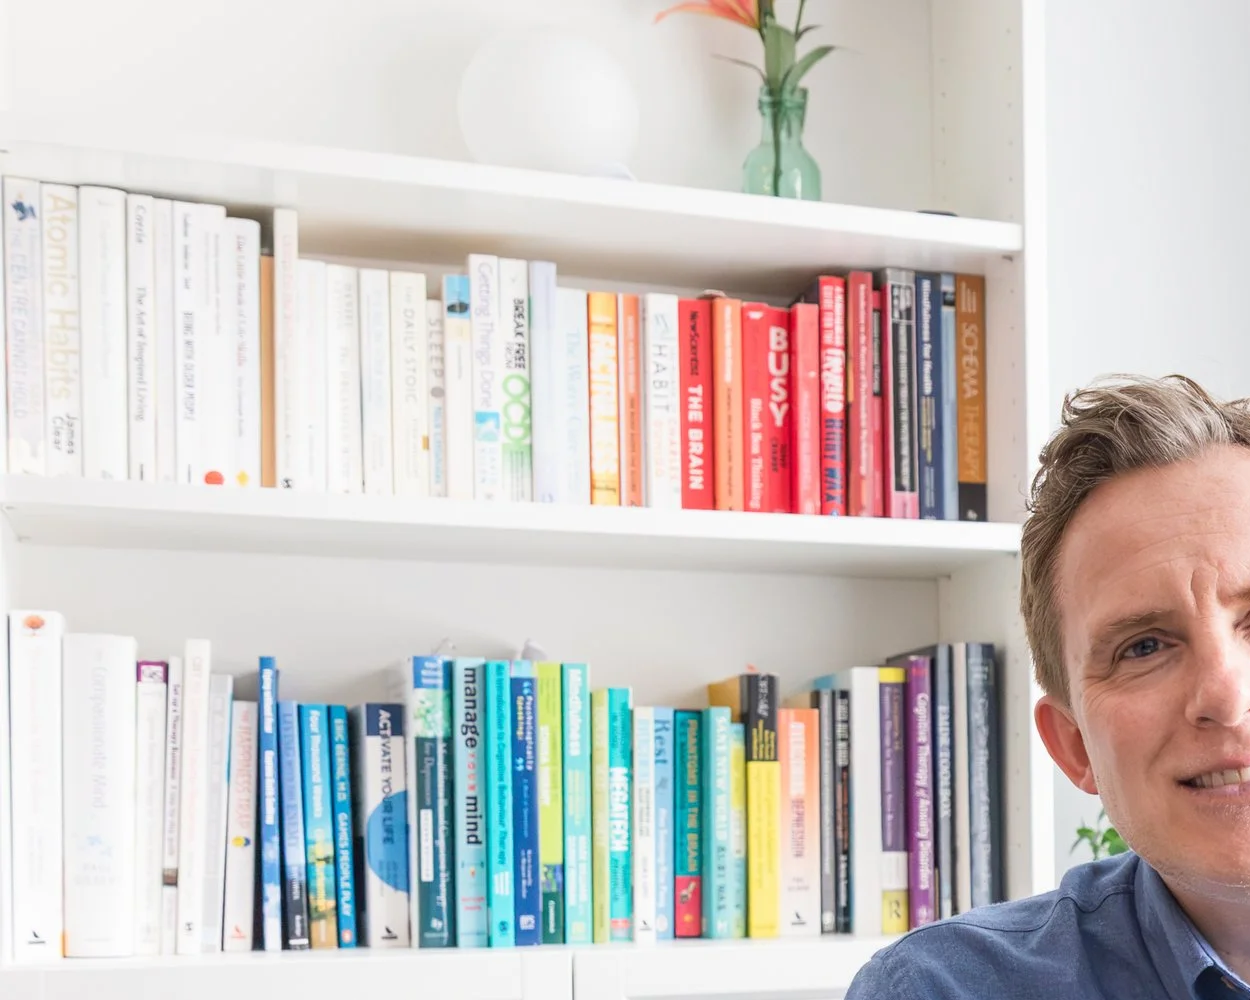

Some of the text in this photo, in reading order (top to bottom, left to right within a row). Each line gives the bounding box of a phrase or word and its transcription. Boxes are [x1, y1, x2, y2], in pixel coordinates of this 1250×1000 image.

[46, 194, 77, 400] Atomic Habits
[922, 279, 932, 342] Mindfulness
[403, 308, 418, 404] DAILY STOIC
[429, 317, 445, 378] SLEEP
[475, 262, 495, 409] Getting Things Done
[513, 298, 526, 370] BREAK FREE
[923, 343, 932, 359] for
[961, 322, 980, 399] SCHEMA
[652, 344, 670, 414] HABIT
[768, 325, 788, 428] BUSY
[923, 360, 933, 396] Health
[52, 416, 64, 451] Clear
[66, 413, 79, 455] James
[503, 374, 531, 443] OCD
[688, 384, 704, 491] THE BRAIN
[749, 398, 763, 509] Black Box Thinking
[963, 405, 981, 479] THERAPY
[825, 467, 844, 505] WAX
[334, 718, 345, 742] ERIC
[460, 667, 480, 749] manage
[568, 668, 583, 757] Mindfulness
[915, 693, 930, 744] Cognitive
[309, 710, 323, 818] Four Thousand Weeks
[378, 709, 393, 773] ACTIVATE
[654, 719, 672, 765] Rest
[687, 719, 698, 786] PHANTOMS
[915, 745, 931, 787] Therapy
[938, 705, 953, 819] EMDR TOOLBOX
[91, 774, 110, 809] Mind
[381, 777, 394, 814] YOUR
[464, 795, 483, 846] mind
[609, 767, 629, 852] MEGATECH
[688, 807, 698, 829] THE
[715, 794, 728, 842] WORLD
[916, 799, 931, 839] Anxiety
[382, 817, 396, 847] LIFE
[687, 833, 698, 872] BRAIN
[791, 798, 806, 859] DEPRESSION
[338, 812, 353, 918] GAMES PEOPLE PLAY
[918, 840, 932, 890] Disorders
